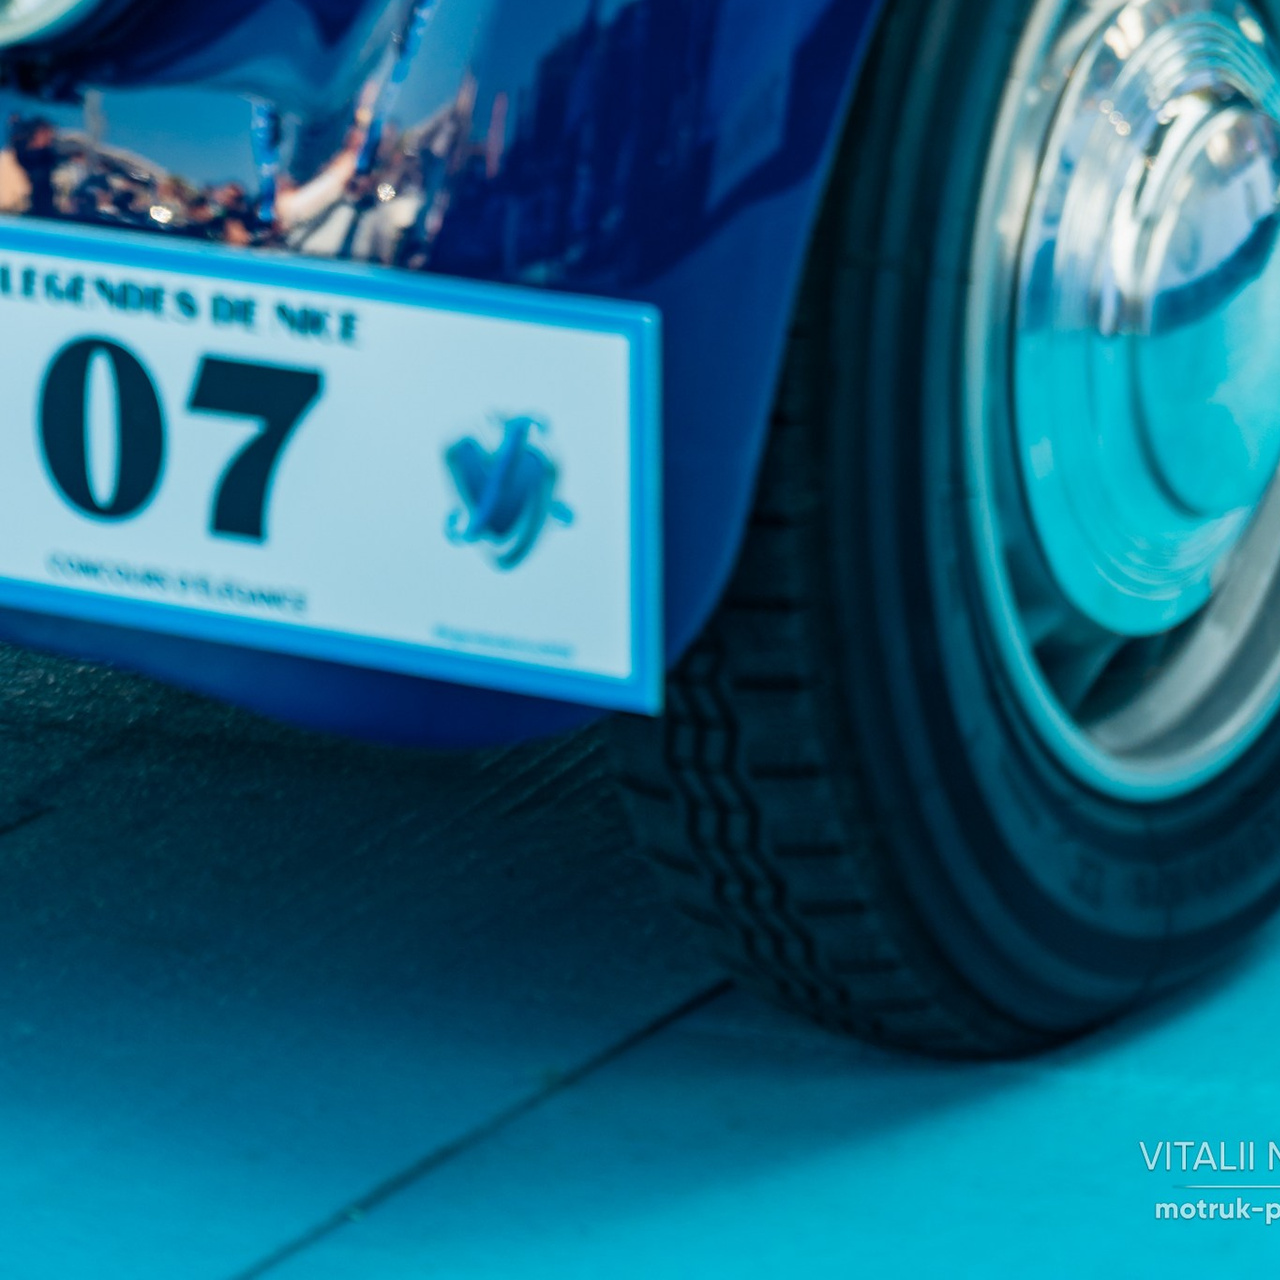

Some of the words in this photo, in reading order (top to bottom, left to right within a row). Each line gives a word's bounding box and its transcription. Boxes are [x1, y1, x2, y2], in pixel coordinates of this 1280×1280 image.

[211, 294, 257, 328] DE
[273, 301, 361, 343] NICE
[39, 333, 325, 546] 07
